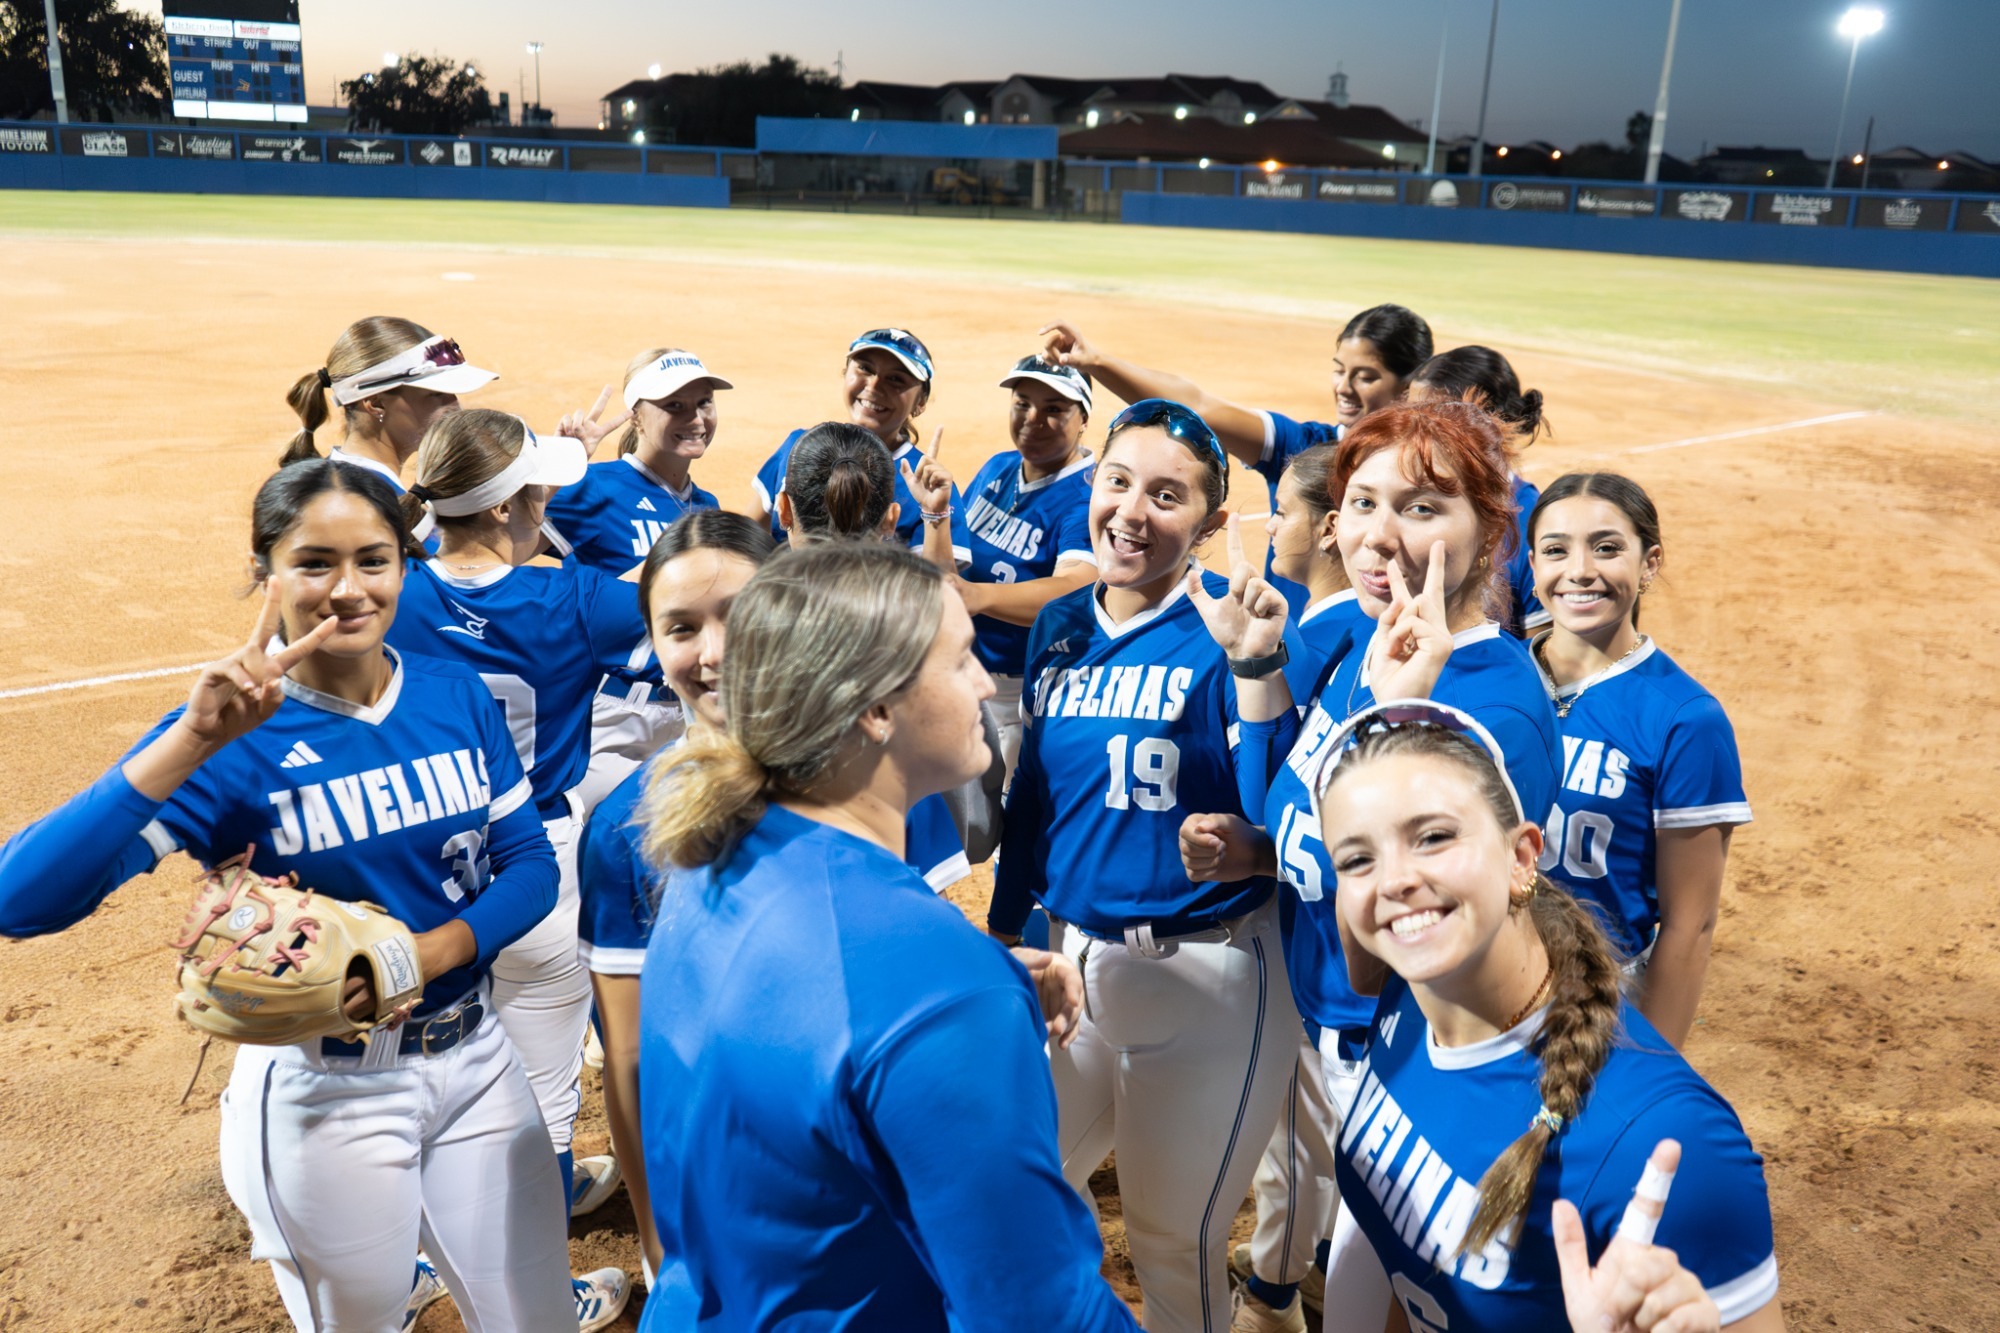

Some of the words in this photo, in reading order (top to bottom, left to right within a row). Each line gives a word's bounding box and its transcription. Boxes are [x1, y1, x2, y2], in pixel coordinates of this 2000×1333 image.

[175, 35, 196, 46] BALL
[204, 37, 233, 49] STRIKE
[243, 39, 260, 50] OUT
[271, 41, 299, 53] INNING
[211, 60, 234, 71] RUNS
[251, 63, 270, 74] HITS
[284, 64, 301, 75] ERR
[173, 70, 204, 83] GUEST
[174, 86, 207, 99] JAVELINAS
[20, 130, 47, 141] SHAW
[255, 138, 292, 148] aramark
[0, 141, 48, 152] TOYOTA
[508, 147, 555, 163] RALLY
[965, 495, 1044, 561] AVELINAS
[1033, 665, 1193, 721] AVELINAS
[1105, 734, 1180, 811] 19
[1276, 803, 1324, 902] 15
[1341, 1053, 1514, 1290] VELINAS
